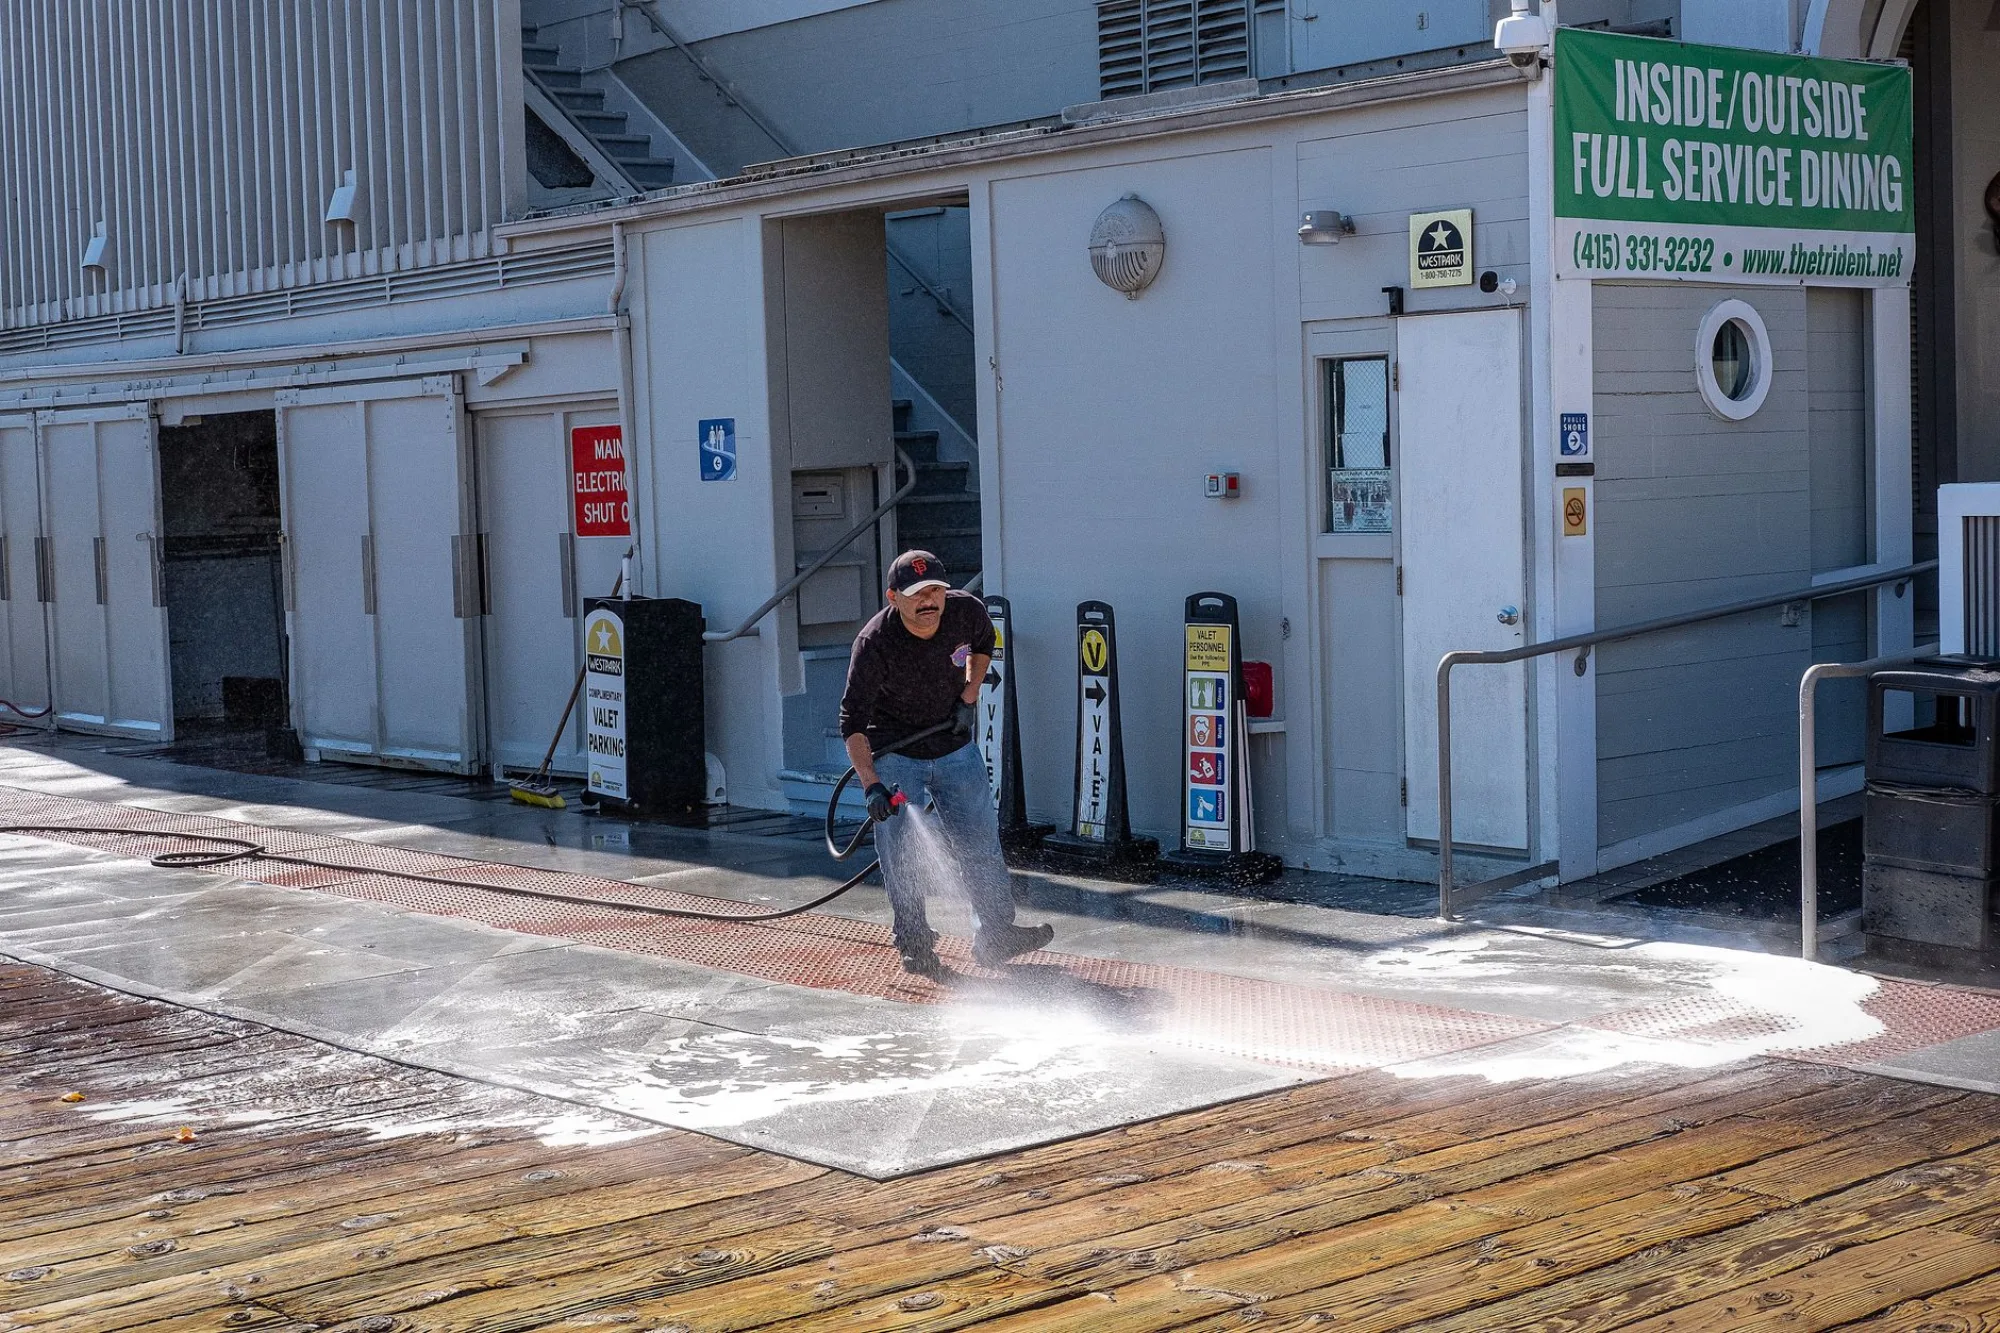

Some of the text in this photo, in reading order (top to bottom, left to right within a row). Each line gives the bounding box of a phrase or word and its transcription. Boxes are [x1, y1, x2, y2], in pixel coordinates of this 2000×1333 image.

[1614, 59, 1869, 141] INSIDE/OUTSIDE
[1572, 132, 1903, 212] FULL SERVICE DINING
[1420, 254, 1463, 268] WESTPARK
[1573, 231, 1903, 278] (415) 331-3232 www.thetrident.net
[1420, 269, 1462, 279] 1-800-750-7275
[594, 439, 625, 460] MAIN
[584, 502, 616, 524] SHUT
[1197, 630, 1217, 640] VALET
[1087, 642, 1102, 668] V
[1189, 642, 1226, 653] PERSONNEL
[589, 656, 621, 674] WESTPARK
[588, 687, 622, 702] COMPLIMENTARY
[592, 706, 619, 729] VALET
[588, 732, 624, 758] PARKING
[984, 703, 997, 793] VALE
[1092, 714, 1103, 820] VALET
